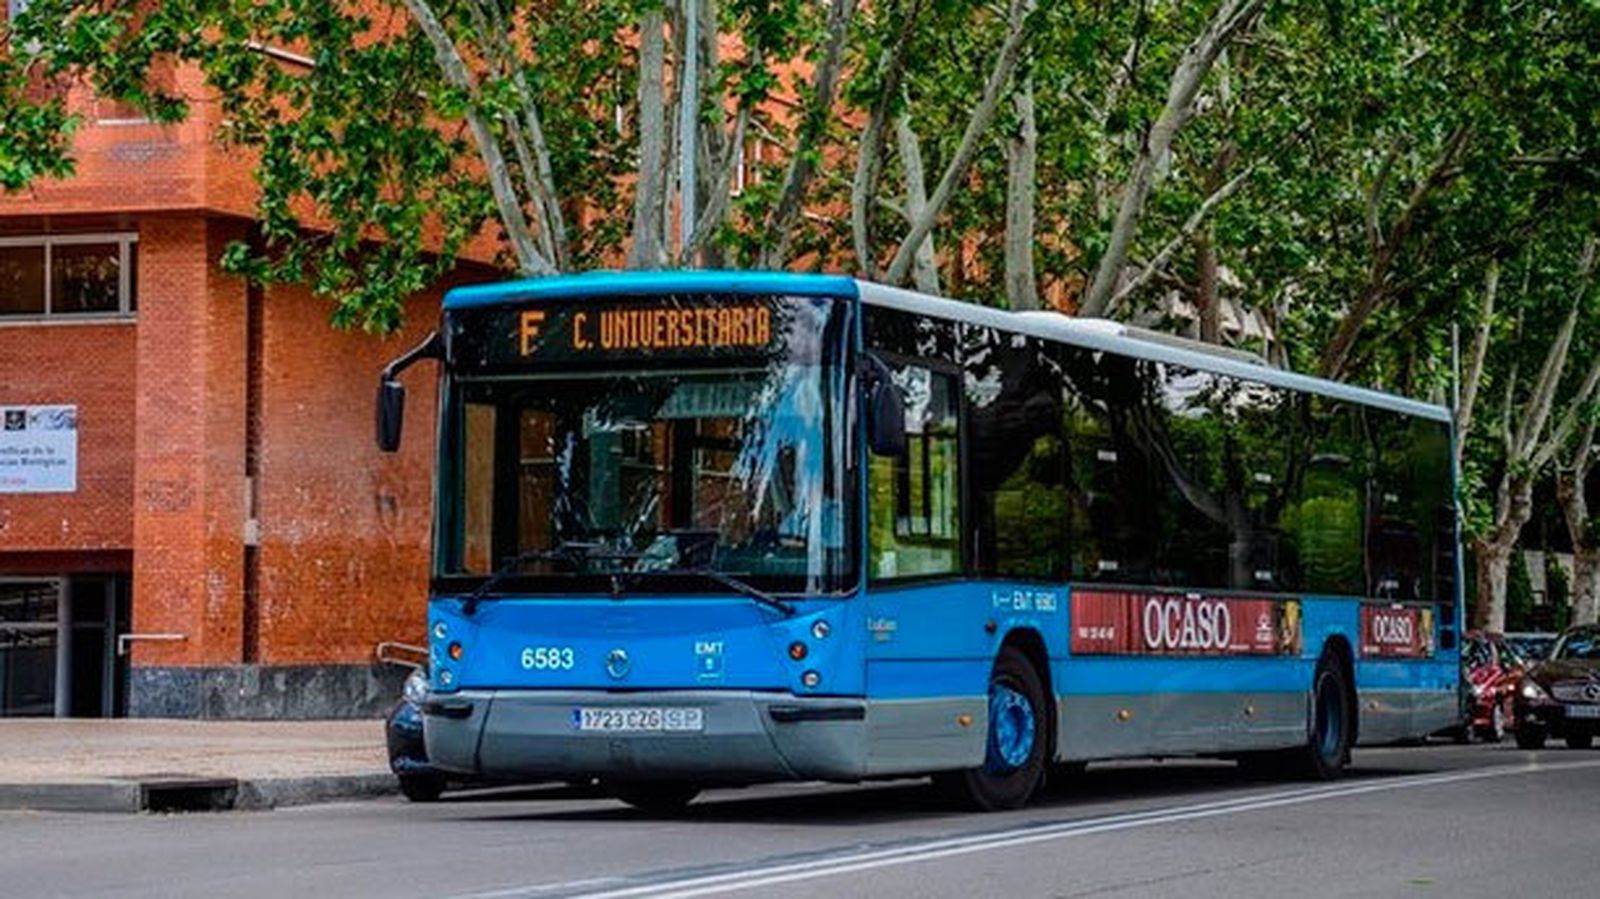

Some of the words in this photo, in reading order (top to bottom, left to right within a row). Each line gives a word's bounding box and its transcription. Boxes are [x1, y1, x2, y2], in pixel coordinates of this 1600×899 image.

[520, 310, 545, 356] F
[573, 313, 594, 349] C.
[601, 307, 770, 348] UNIVERSITARIA
[1144, 598, 1231, 648] OCASO
[1374, 615, 1412, 644] OCASO
[521, 647, 574, 670] 6583
[695, 641, 723, 654] EMT
[584, 709, 623, 728] 1723
